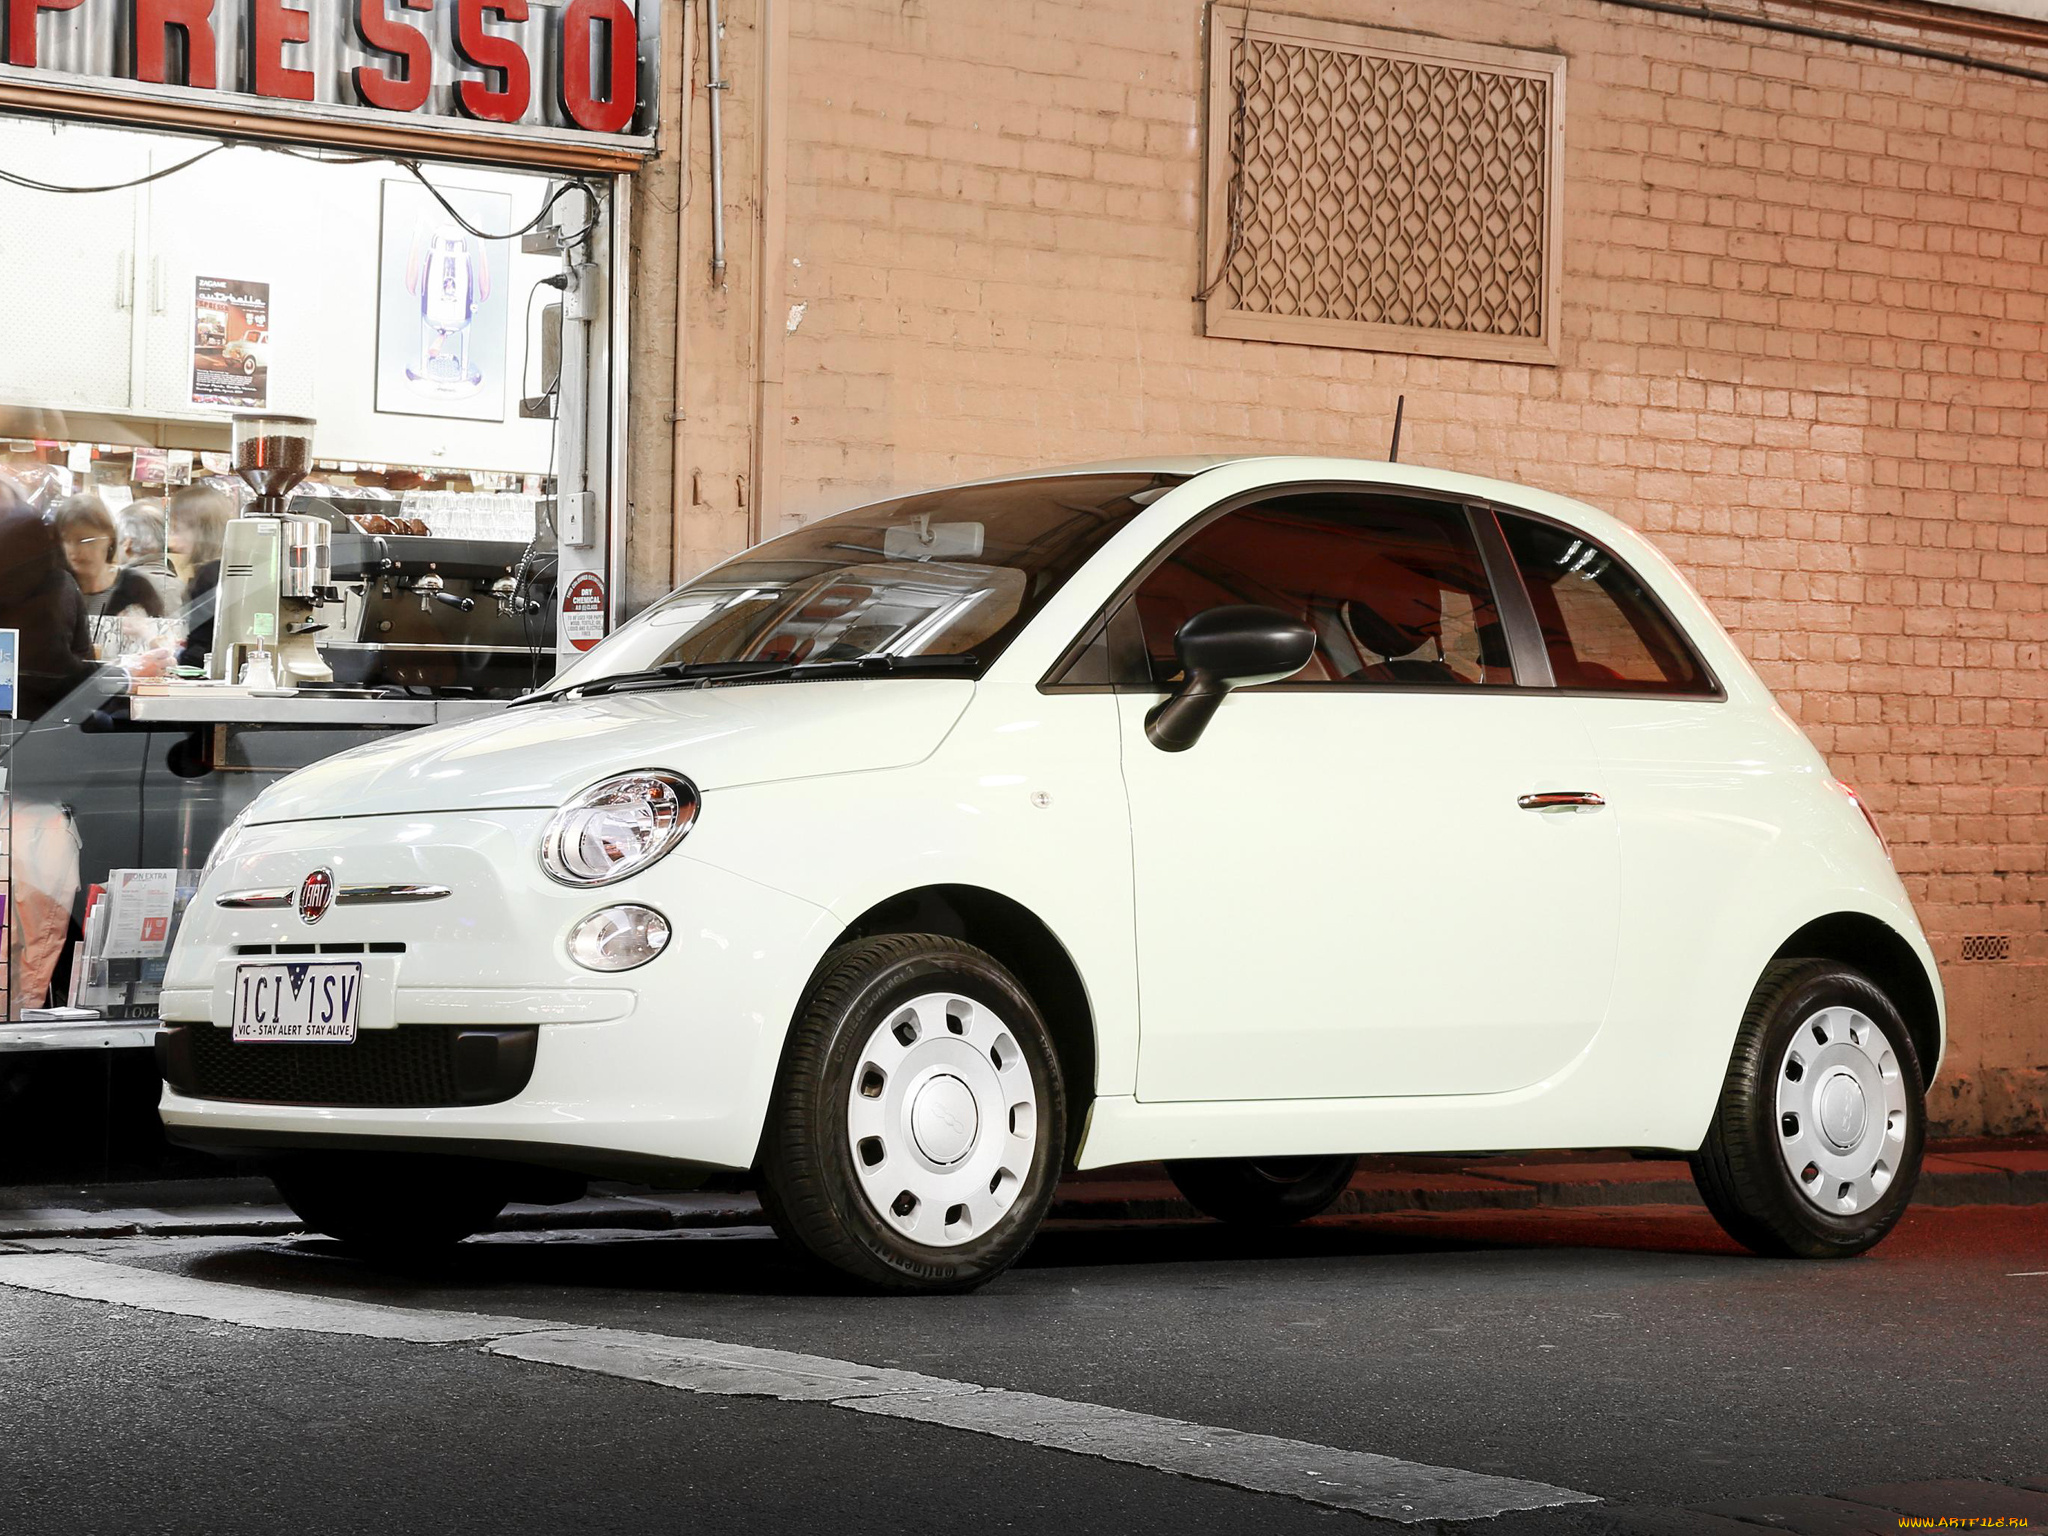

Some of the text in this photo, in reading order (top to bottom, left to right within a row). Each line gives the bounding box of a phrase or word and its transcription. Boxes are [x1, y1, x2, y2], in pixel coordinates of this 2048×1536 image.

[581, 588, 593, 596] DRY
[572, 596, 601, 604] CHEMICAL
[144, 872, 168, 880] EXTRA
[305, 883, 328, 908] FIAT
[238, 1025, 250, 1036] VIC
[258, 1025, 277, 1036] STAY
[278, 1025, 302, 1036] ALERT
[306, 1025, 325, 1036] STAY
[325, 1025, 350, 1036] ALIVE
